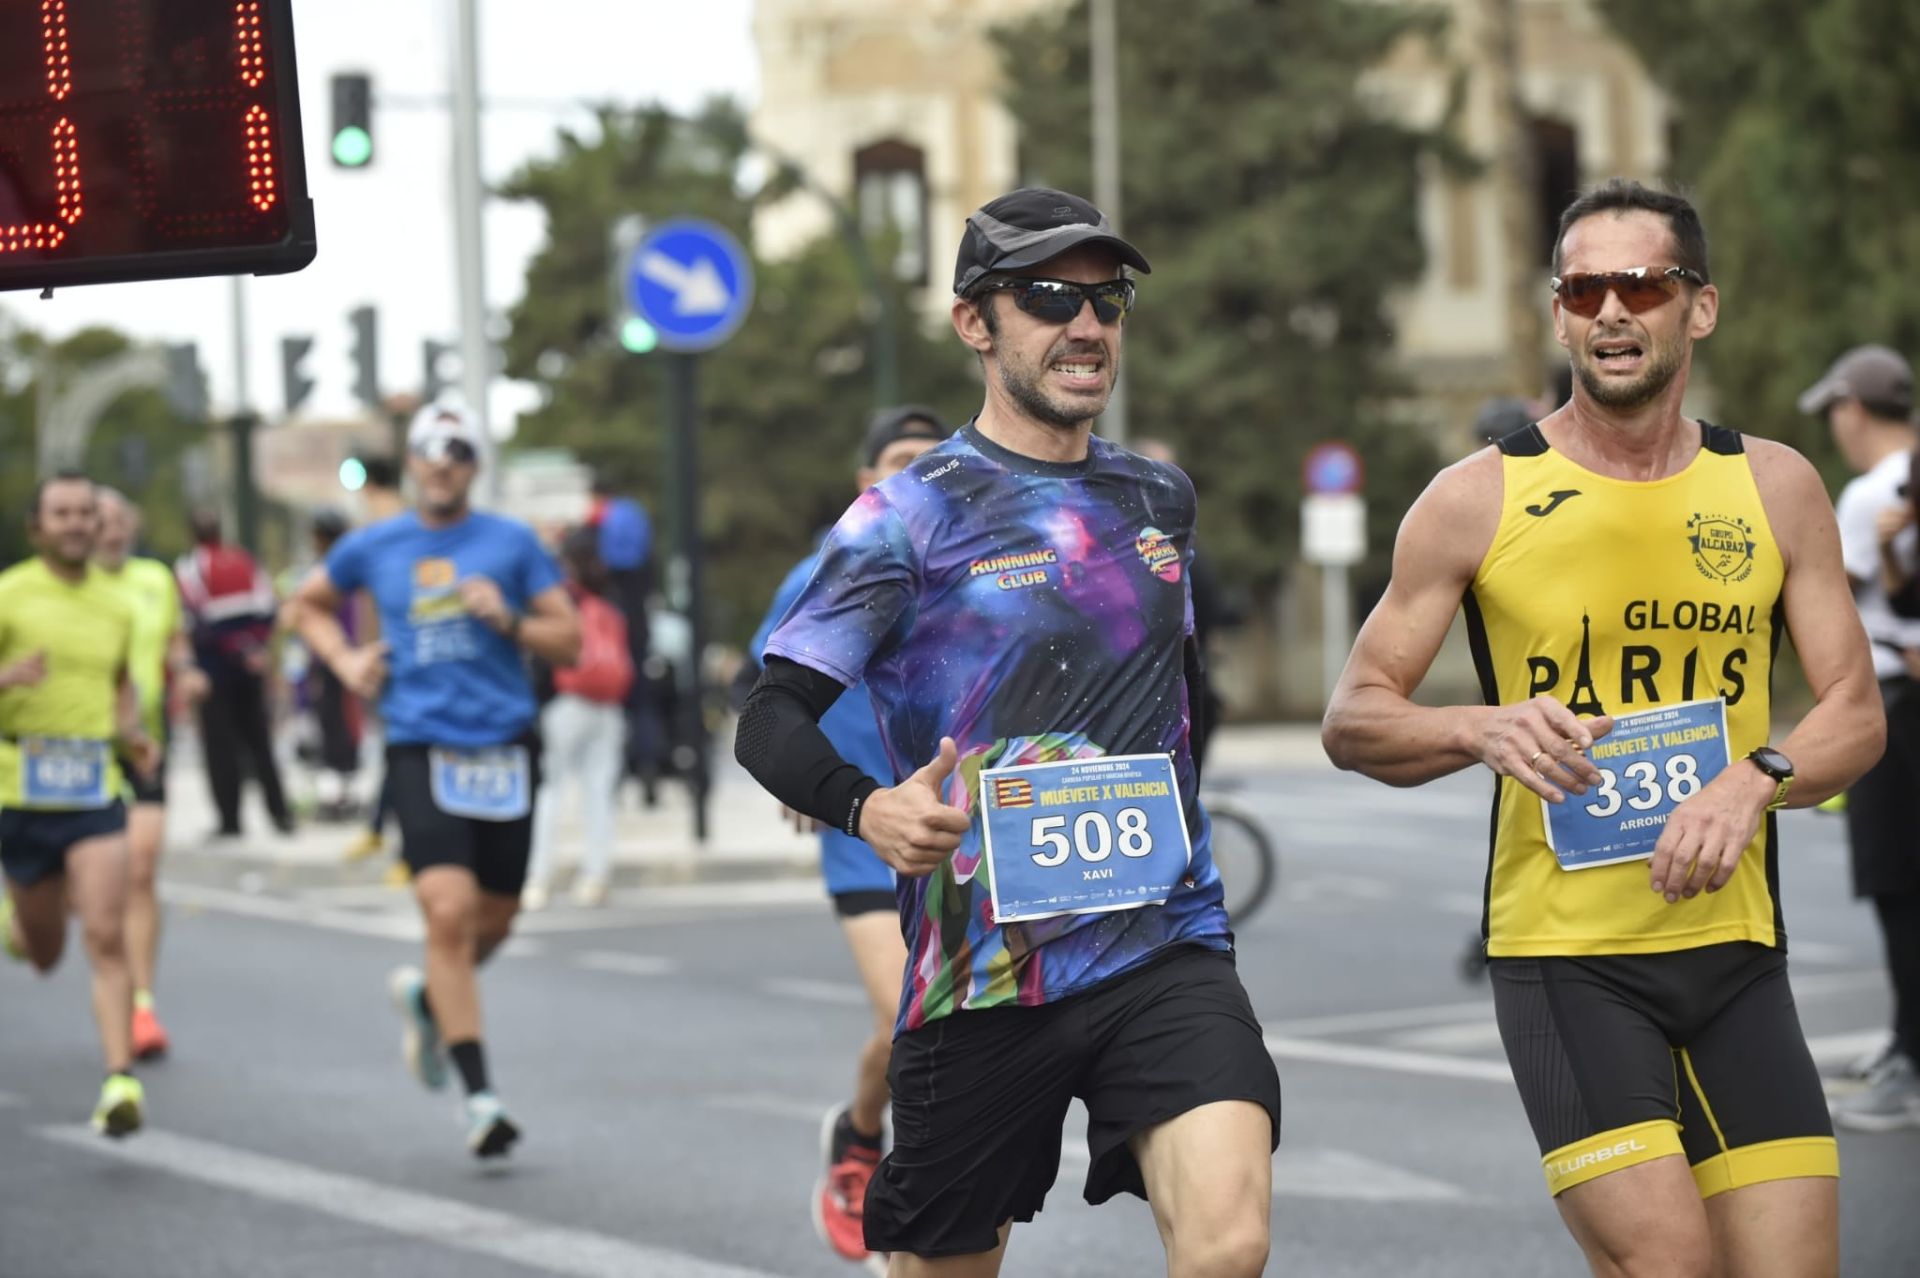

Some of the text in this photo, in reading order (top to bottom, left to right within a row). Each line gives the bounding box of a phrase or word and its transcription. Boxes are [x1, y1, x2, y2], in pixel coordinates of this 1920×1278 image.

[921, 458, 960, 483] ARGIUS
[1700, 537, 1745, 553] ALCARAZ
[969, 548, 1057, 576] RUNNING
[997, 570, 1047, 590] CLUB
[1624, 599, 1755, 634] GLOBAL
[1591, 723, 1719, 760] MUÉVETE X VALENCIA
[1040, 781, 1169, 807] MUÉVETE X VALENCIA
[1584, 753, 1702, 818] 338
[1030, 806, 1153, 867] 508
[1082, 867, 1113, 881] XAVI
[1558, 1139, 1648, 1175] LURBEL
